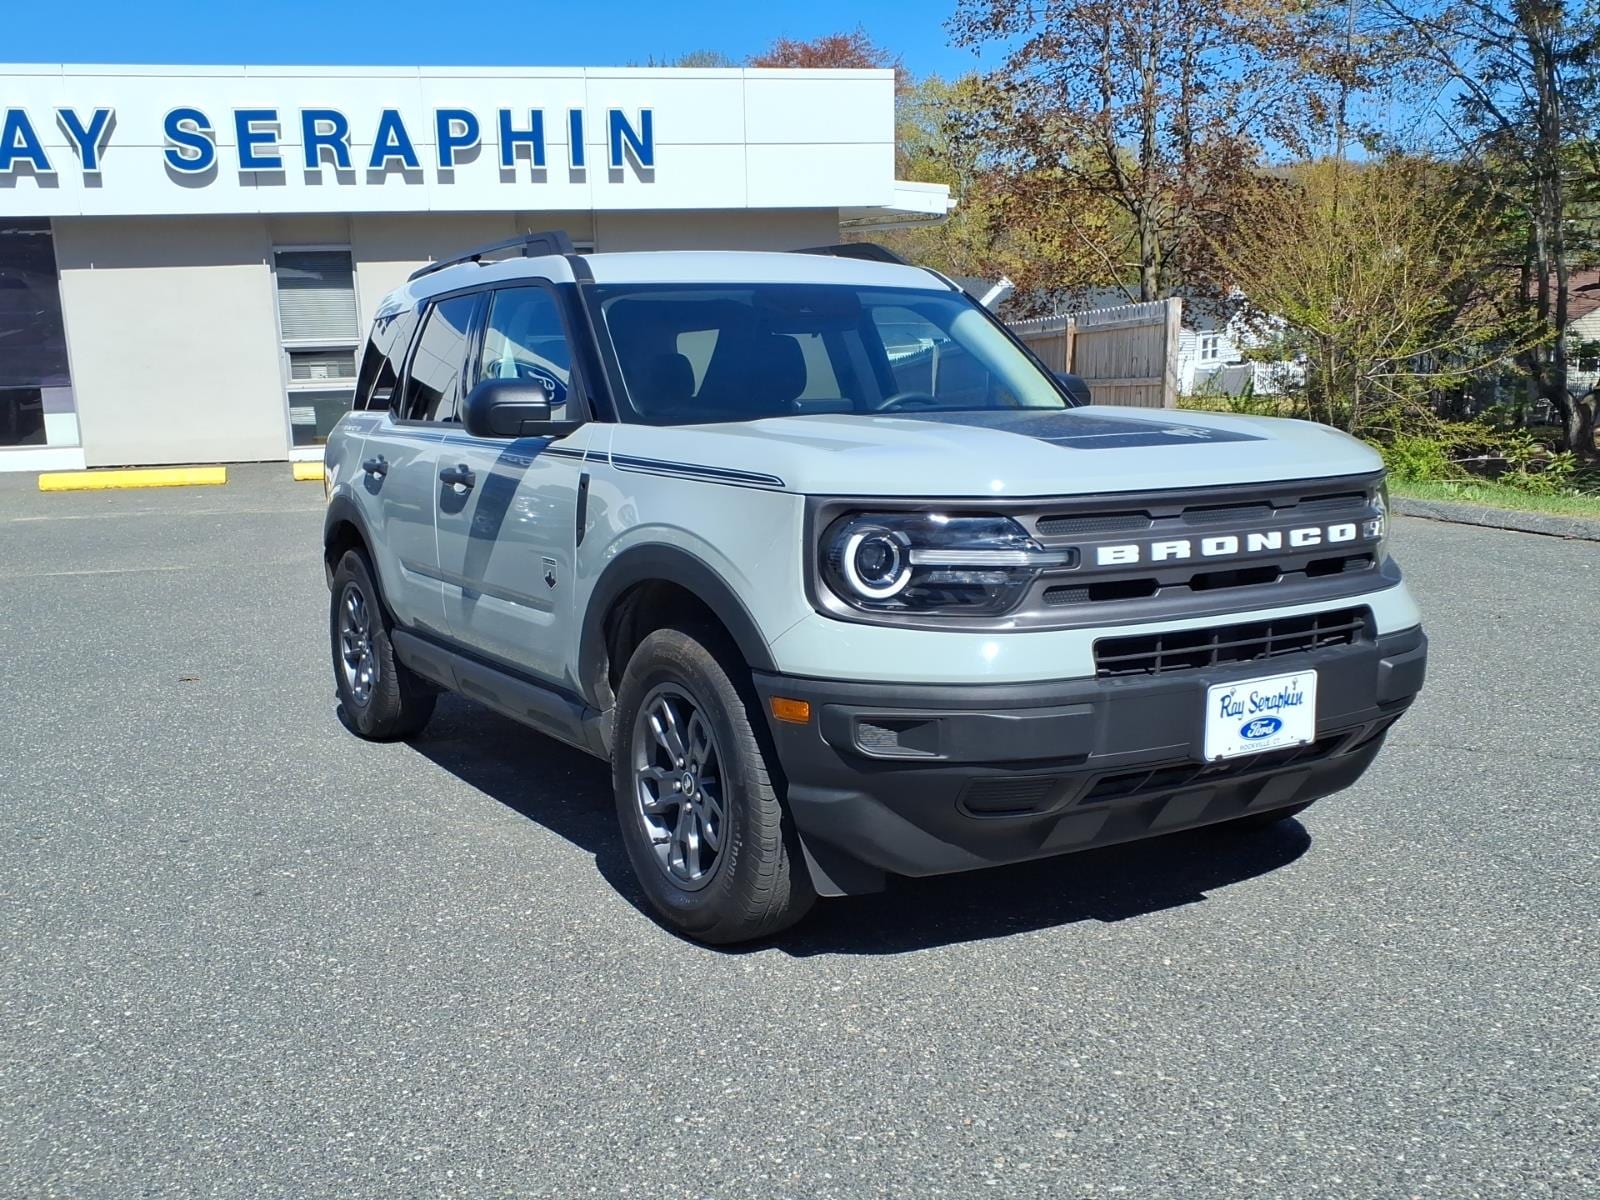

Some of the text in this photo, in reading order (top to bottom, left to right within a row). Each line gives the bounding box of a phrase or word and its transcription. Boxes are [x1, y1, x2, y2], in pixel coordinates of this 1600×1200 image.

[162, 106, 656, 172] SERAPHIN
[1096, 523, 1357, 566] BRONCO
[1220, 685, 1304, 720] Ray Seraphin
[1246, 719, 1277, 738] Ford
